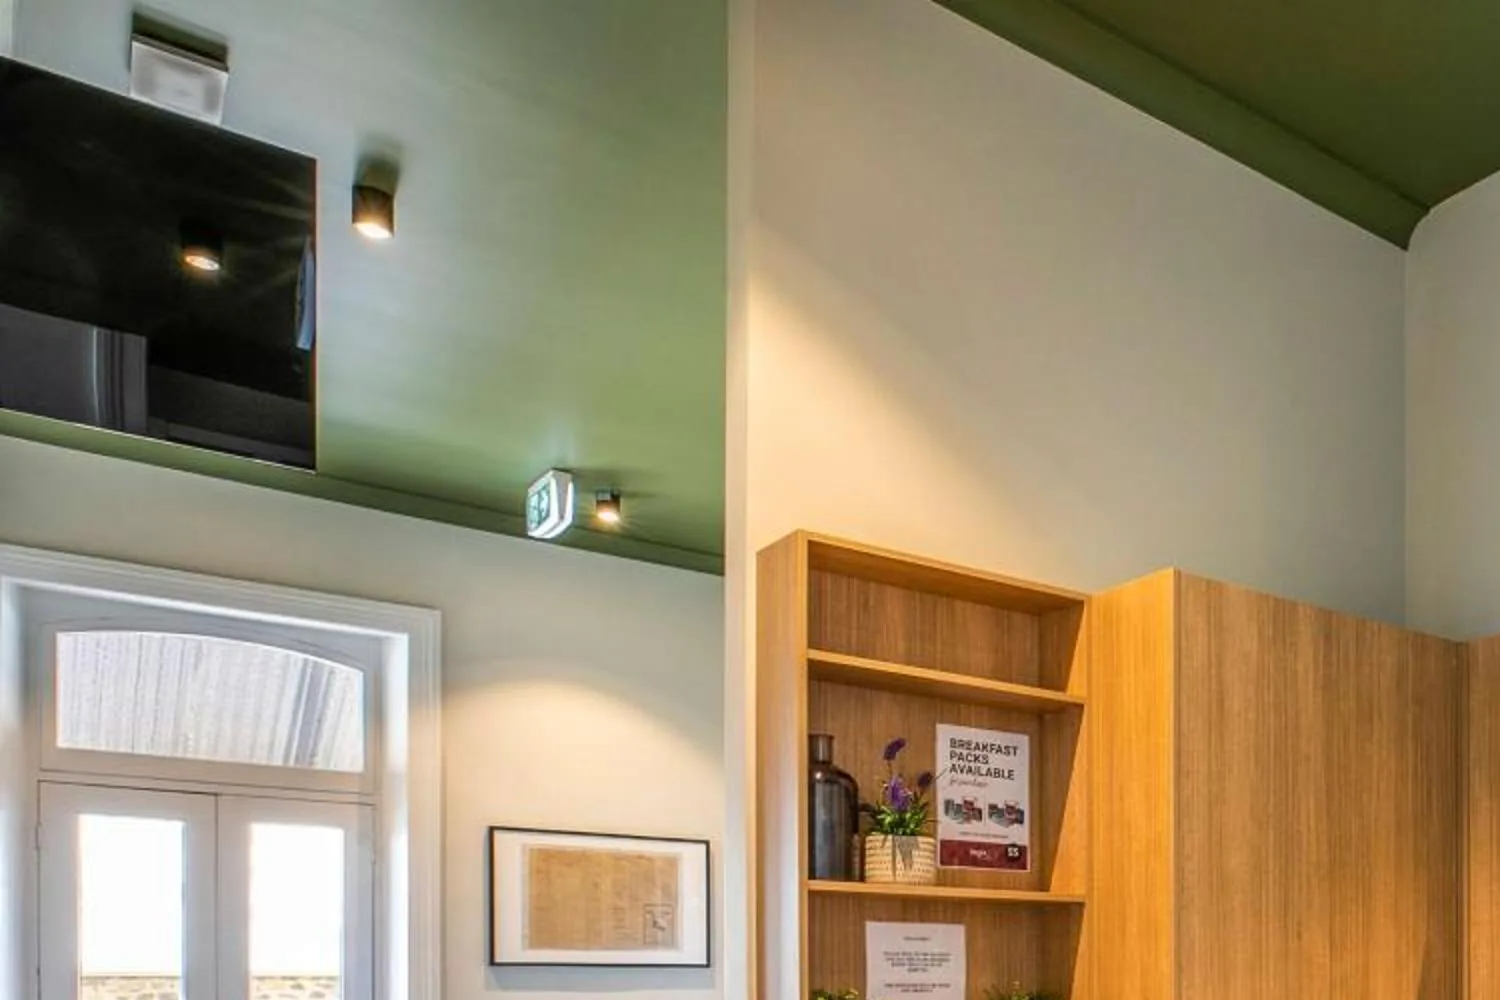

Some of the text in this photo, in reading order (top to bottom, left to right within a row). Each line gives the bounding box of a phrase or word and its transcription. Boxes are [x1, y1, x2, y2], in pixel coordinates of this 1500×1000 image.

[949, 737, 1019, 757] BREAKFAST
[949, 750, 990, 765] PACKS
[949, 763, 1016, 781] AVAILABLE
